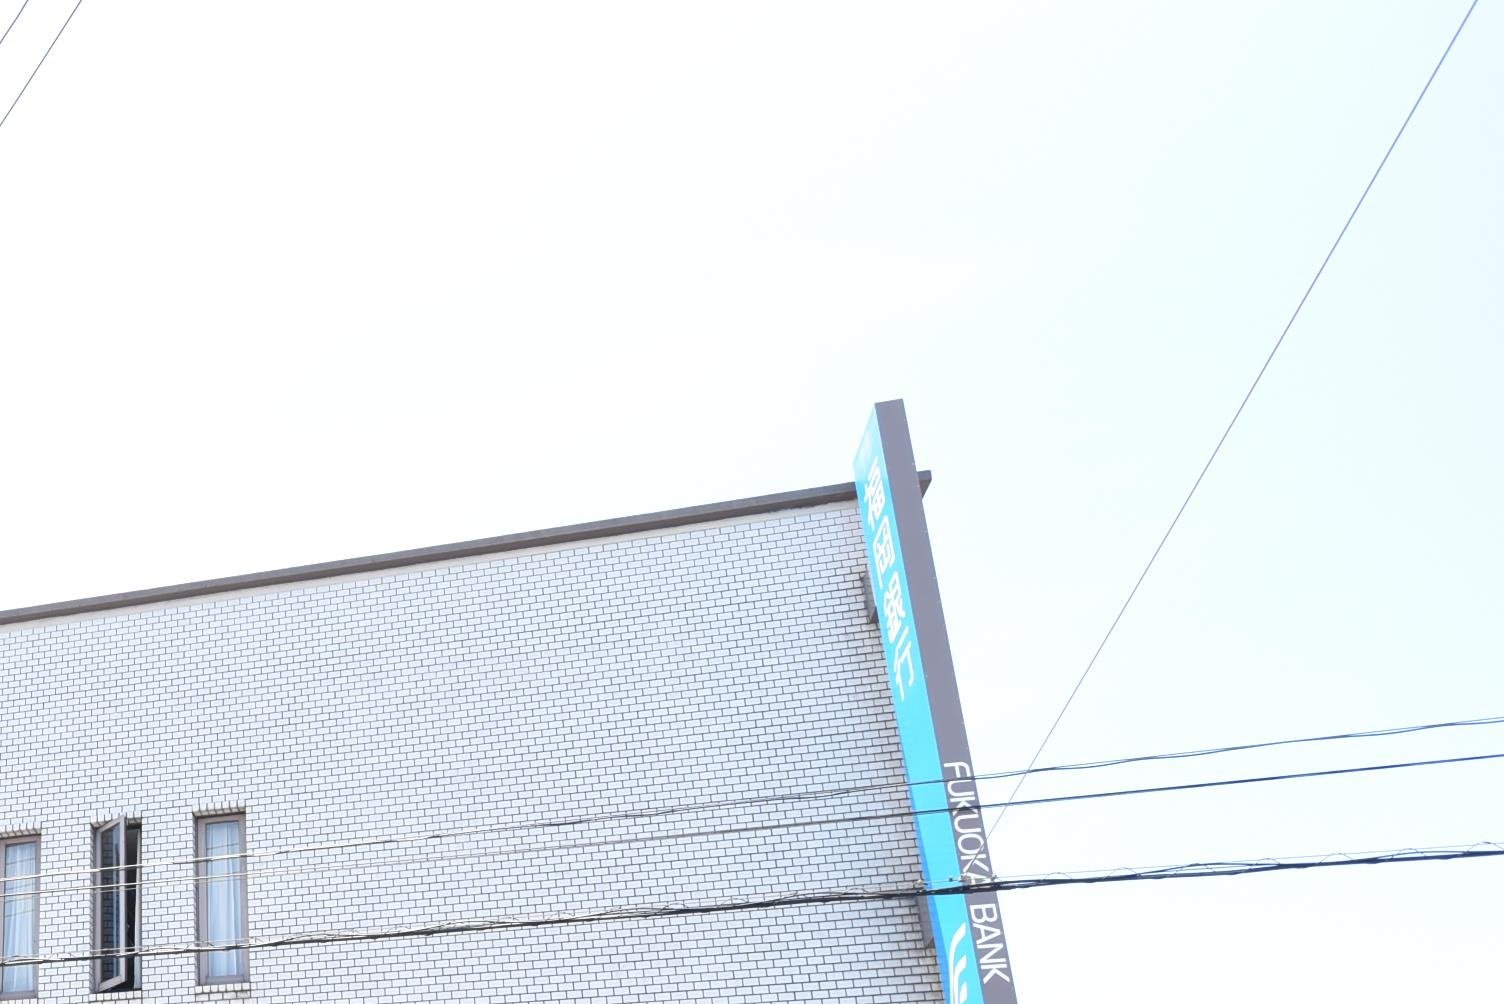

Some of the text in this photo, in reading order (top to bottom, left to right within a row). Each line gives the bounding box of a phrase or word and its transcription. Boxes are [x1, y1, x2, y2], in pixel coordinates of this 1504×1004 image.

[864, 456, 914, 701] 福岡銀行
[944, 761, 1010, 985] FUKUOKA BANK
